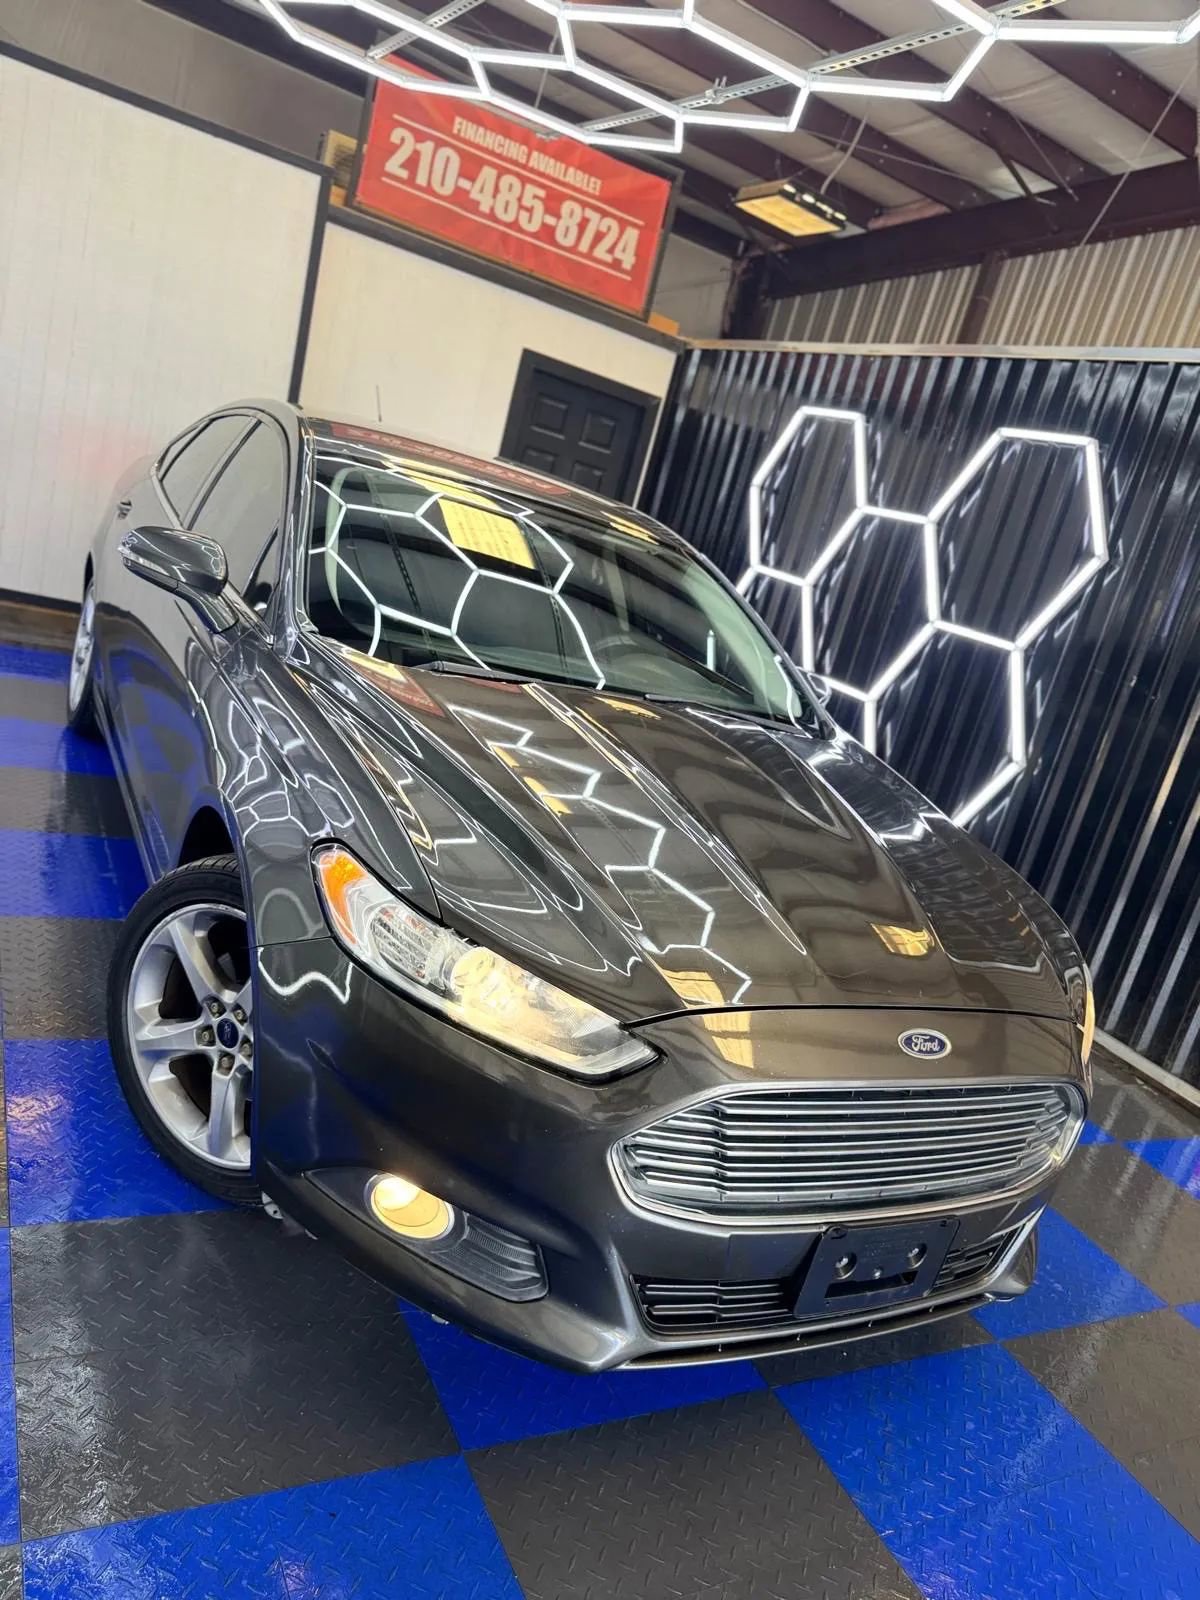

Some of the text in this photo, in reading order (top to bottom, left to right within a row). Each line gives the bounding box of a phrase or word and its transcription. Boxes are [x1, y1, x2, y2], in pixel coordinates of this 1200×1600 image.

[452, 116, 602, 196] FINANCING AVAILABLE!
[384, 127, 640, 271] 210-485-8724
[911, 1035, 940, 1052] Ford
